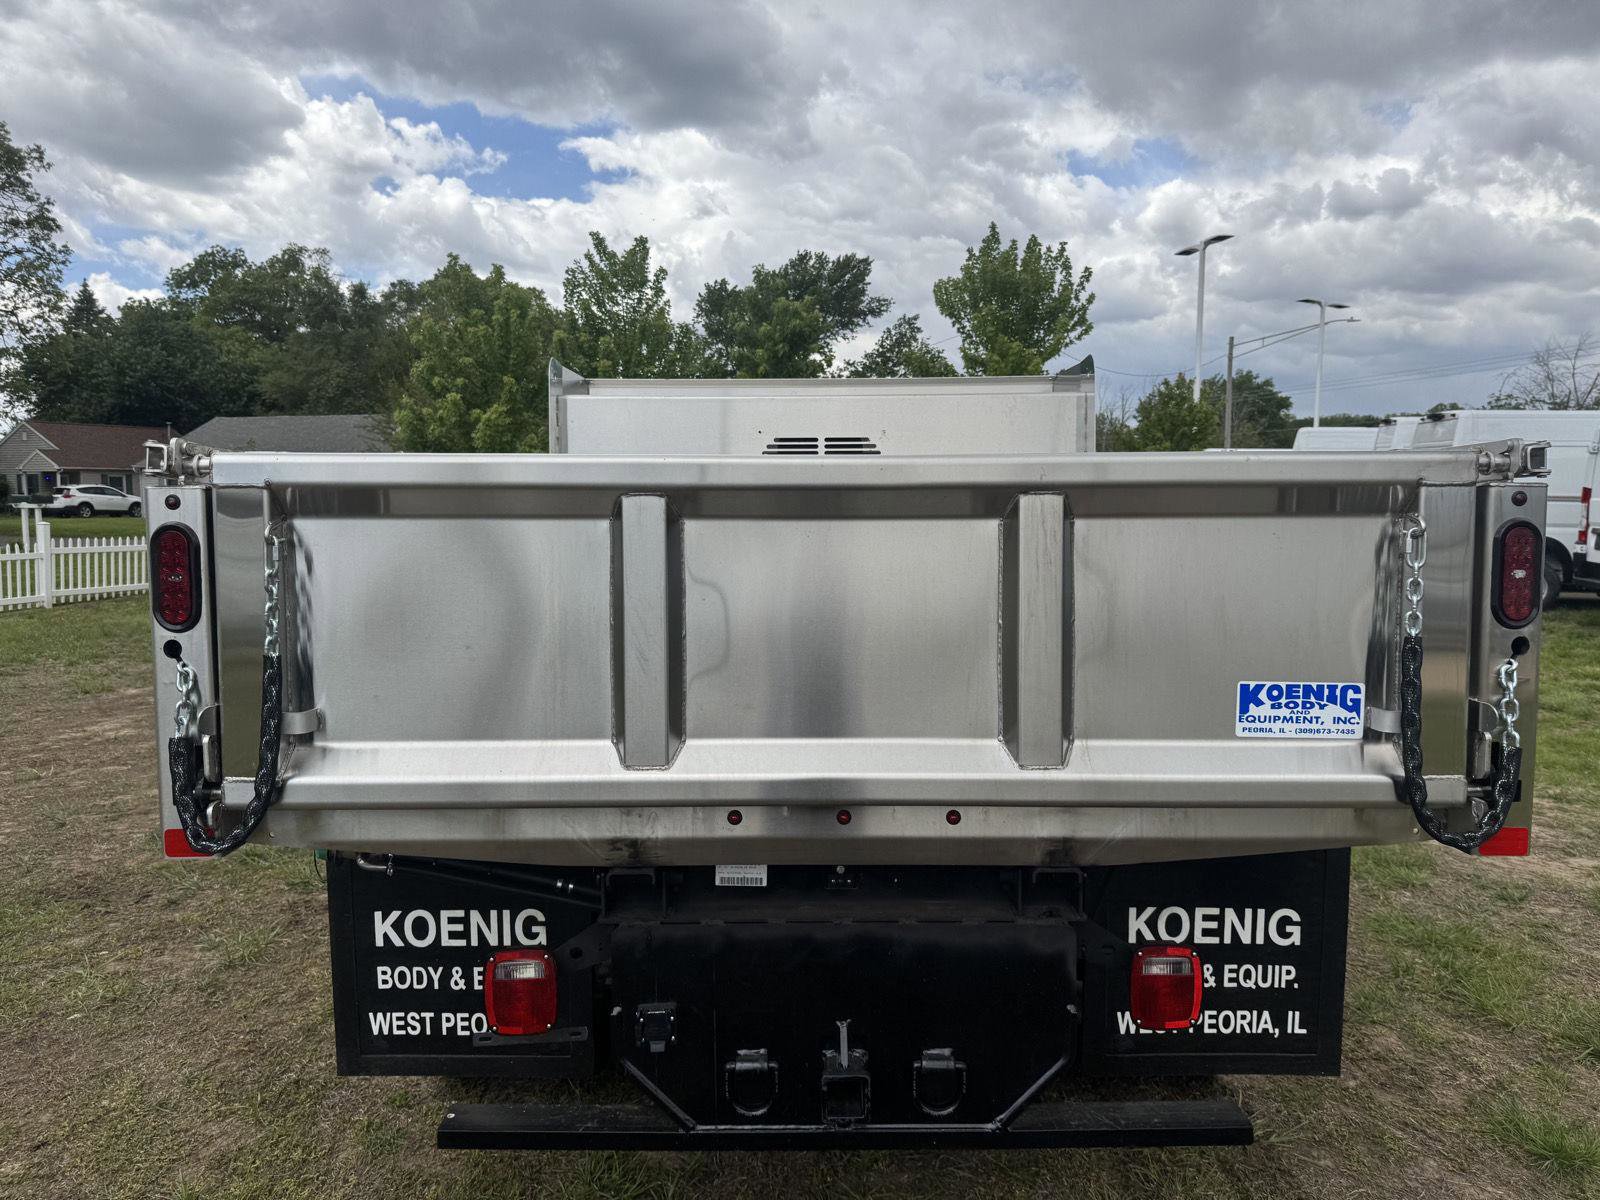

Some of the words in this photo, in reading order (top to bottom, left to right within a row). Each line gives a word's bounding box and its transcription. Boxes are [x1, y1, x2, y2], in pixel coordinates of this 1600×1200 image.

[1239, 683, 1362, 720] KOENIG
[1270, 700, 1330, 710] BODY
[1238, 714, 1324, 726] EQUIPMENT,
[1332, 716, 1360, 725] INC.
[374, 908, 547, 947] KOENIG
[1128, 906, 1301, 946] KOENIG
[377, 966, 443, 990] BODY
[450, 966, 467, 990] &
[1224, 964, 1299, 990] EQUIP.
[369, 1012, 435, 1036] WEST
[1287, 1011, 1308, 1035] IL
